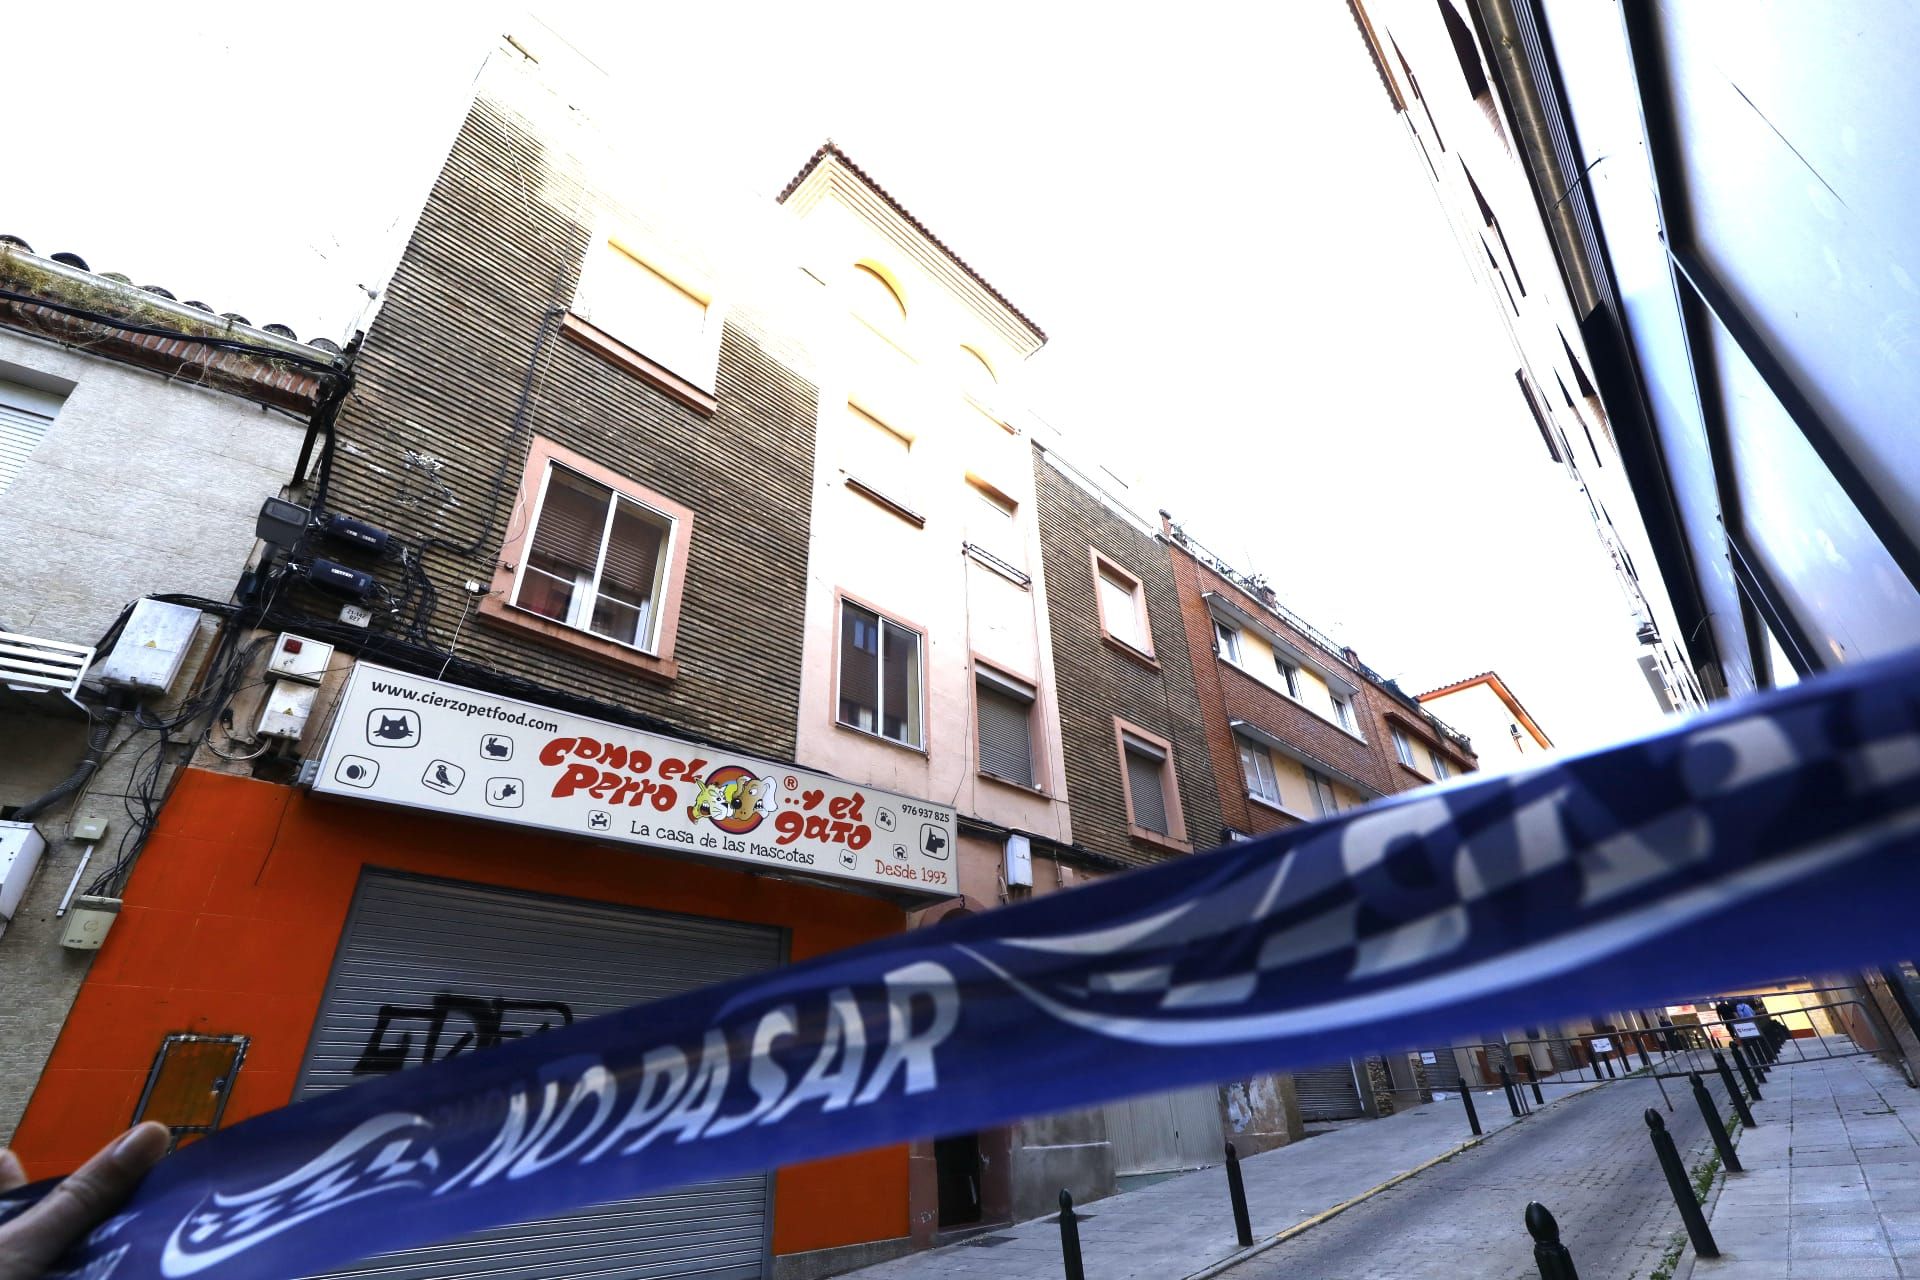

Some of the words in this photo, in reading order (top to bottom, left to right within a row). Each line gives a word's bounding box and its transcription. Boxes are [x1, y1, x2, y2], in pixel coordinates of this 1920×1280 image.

[371, 681, 558, 733] www.cierzopetfood.com
[551, 763, 677, 812] Perro
[901, 804, 917, 816] 976
[918, 807, 933, 819] 937
[934, 812, 950, 823] 825
[630, 820, 650, 836] La
[656, 827, 694, 844] casa
[699, 833, 718, 848] de
[722, 836, 745, 853] las
[750, 842, 815, 865] Mascotas
[875, 859, 917, 880] Desde
[921, 867, 947, 884] 1993
[959, 894, 966, 909] 3
[432, 1065, 617, 1196] NO
[579, 961, 960, 1164] PASAR
